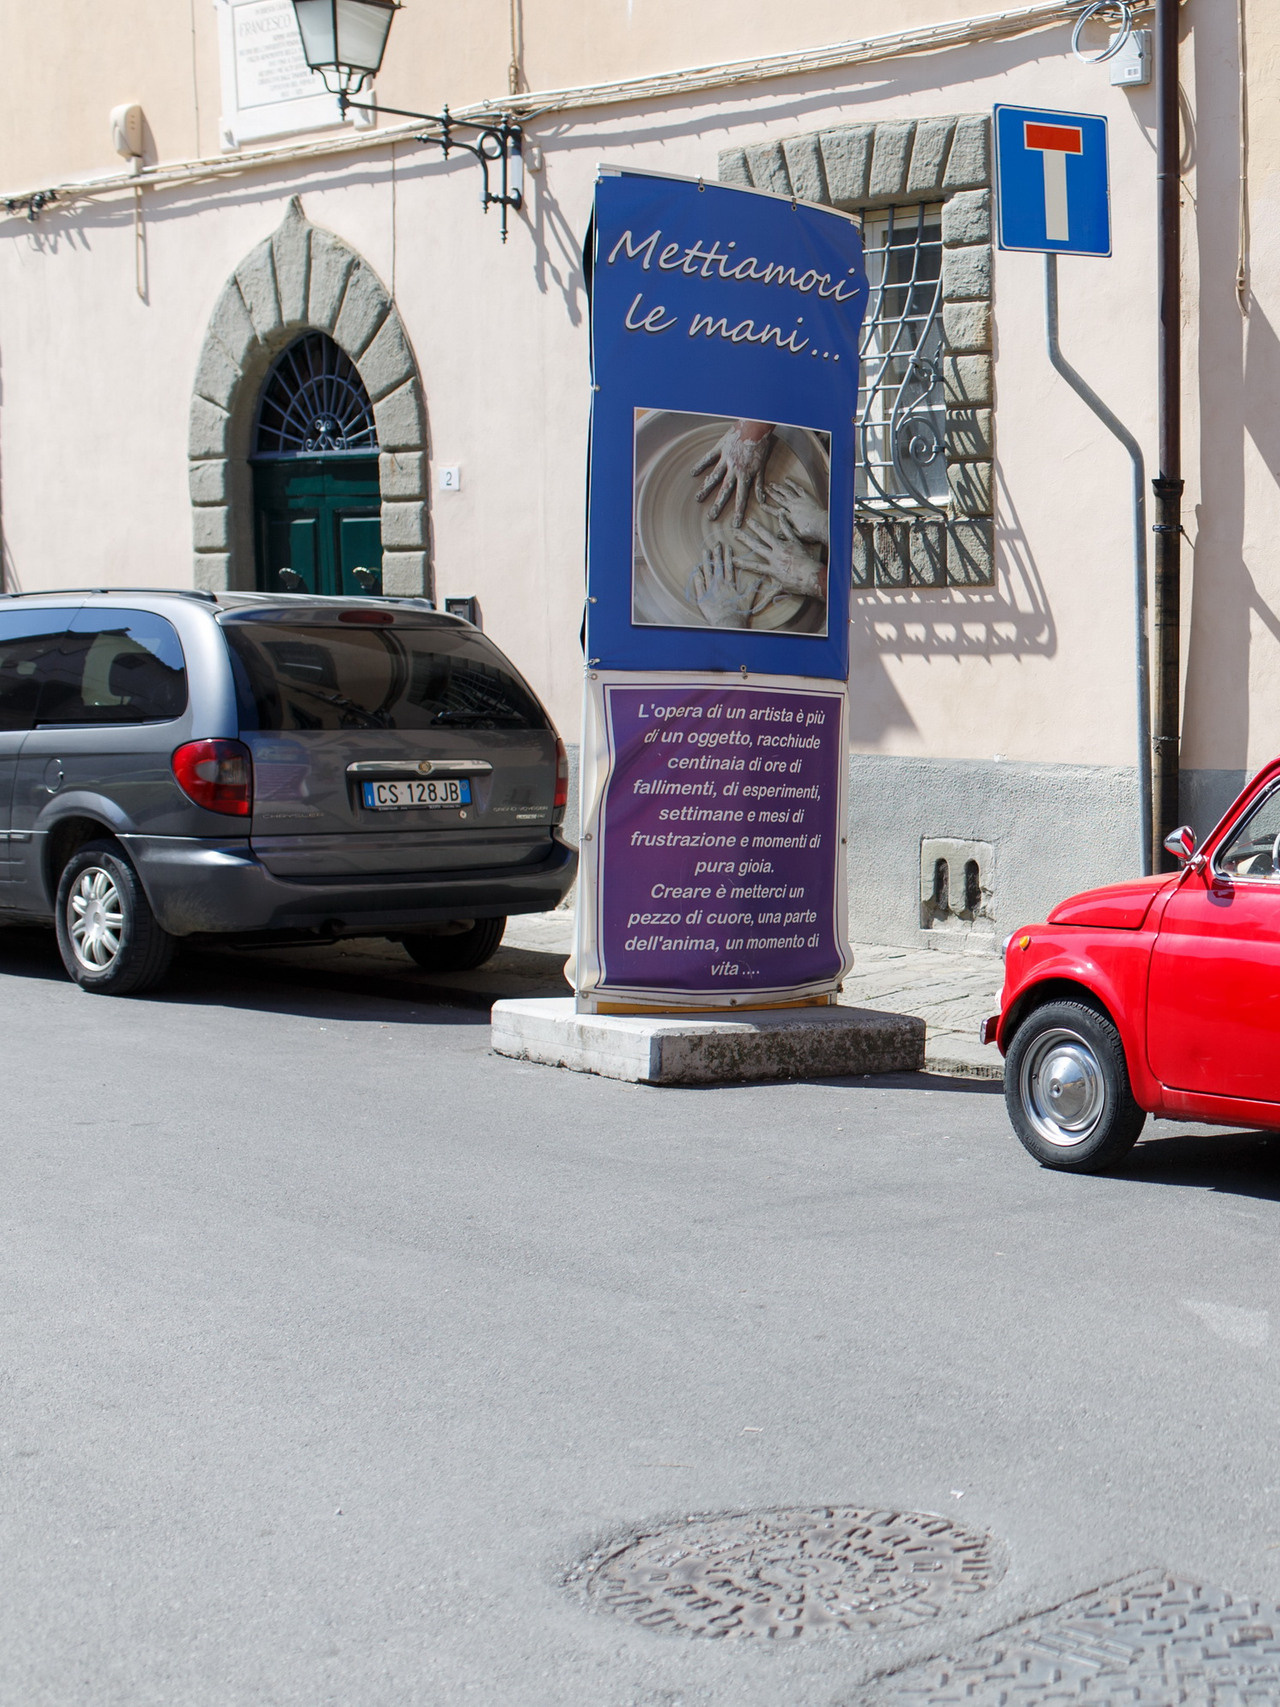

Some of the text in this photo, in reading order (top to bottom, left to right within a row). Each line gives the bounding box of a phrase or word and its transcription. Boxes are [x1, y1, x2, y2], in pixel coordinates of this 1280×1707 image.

[239, 14, 292, 38] FRANCESCO
[607, 229, 861, 302] Mettiamoci
[624, 292, 840, 361] le mani...
[446, 471, 453, 486] 2
[638, 703, 825, 727] L'opera di un artista è più
[644, 729, 820, 749] di un oggetto, racchiude
[668, 756, 801, 773] centinaia di ore di
[377, 784, 399, 804] CS
[407, 782, 459, 802] 128JB
[633, 779, 821, 801] fallimenti, di esperimenti,
[659, 806, 804, 823] settimane e mesi di
[630, 831, 820, 848] frustrazione e momenti di
[694, 859, 774, 876] pura gioia.
[651, 884, 804, 899] Creare è metterci un
[628, 910, 817, 928] pezzo di cuore, una parte
[625, 933, 819, 953] dell'anima, un momento di
